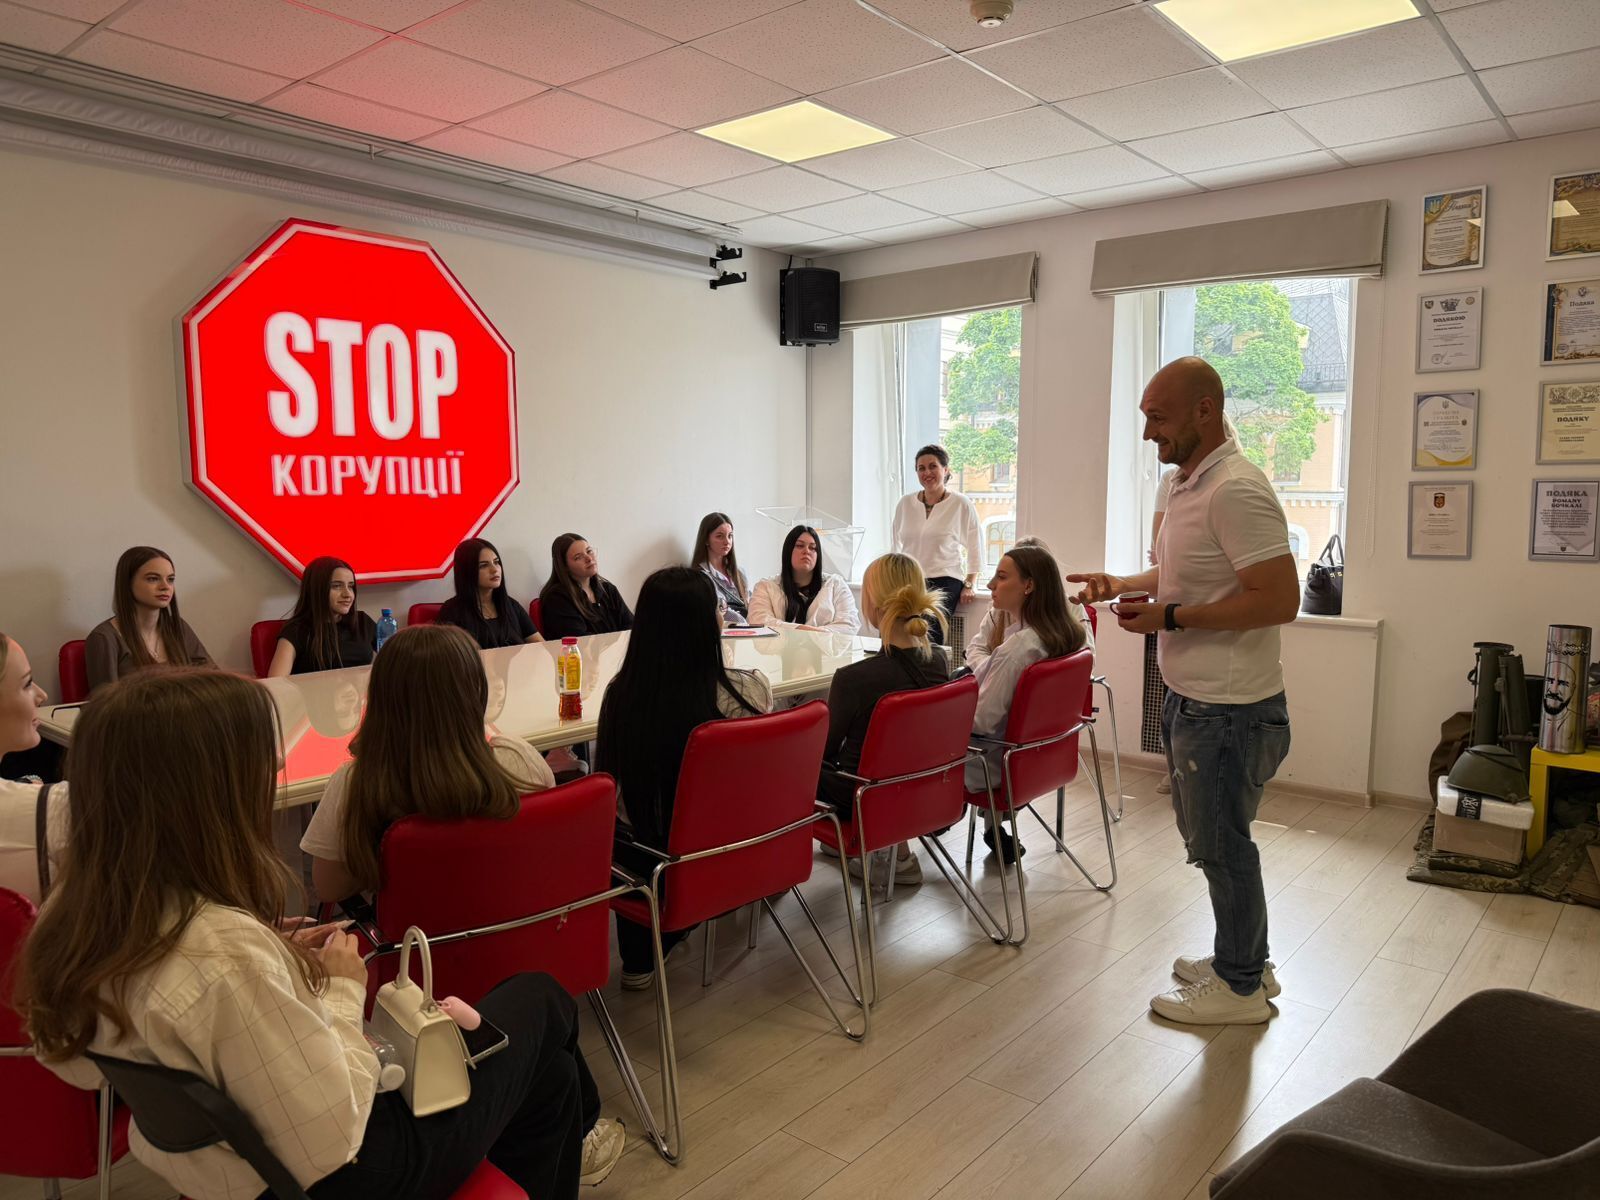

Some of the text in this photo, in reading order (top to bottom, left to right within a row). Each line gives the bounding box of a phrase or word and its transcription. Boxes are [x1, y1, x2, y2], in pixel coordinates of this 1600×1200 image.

[264, 311, 459, 440] STOP
[1557, 415, 1590, 423] ПОДЯКУ
[271, 450, 465, 499] КОРУПЦІЇ
